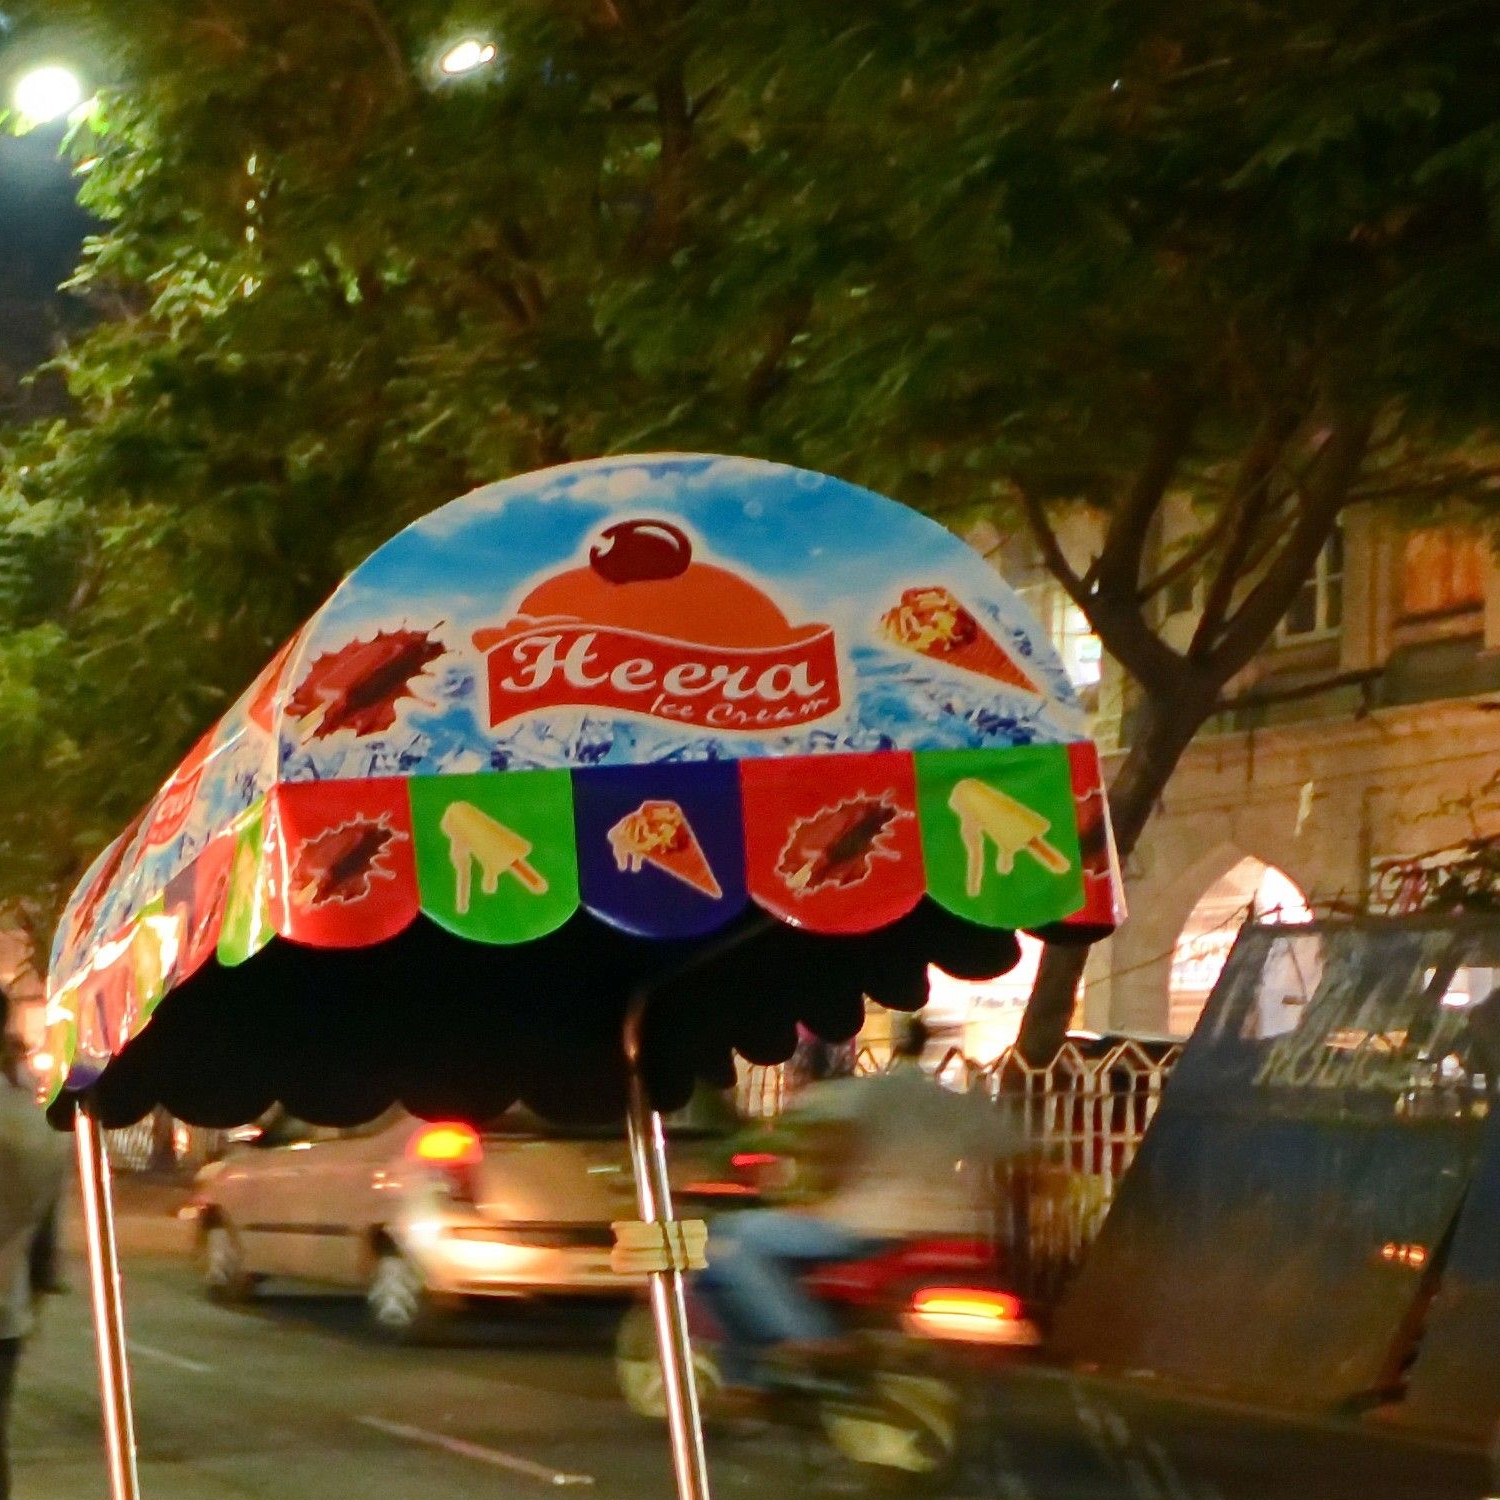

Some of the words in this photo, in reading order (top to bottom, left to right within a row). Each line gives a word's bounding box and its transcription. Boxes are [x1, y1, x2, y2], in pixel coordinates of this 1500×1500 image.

[501, 632, 826, 700] Heera
[650, 694, 695, 718] Ice
[706, 696, 830, 726] Cream
